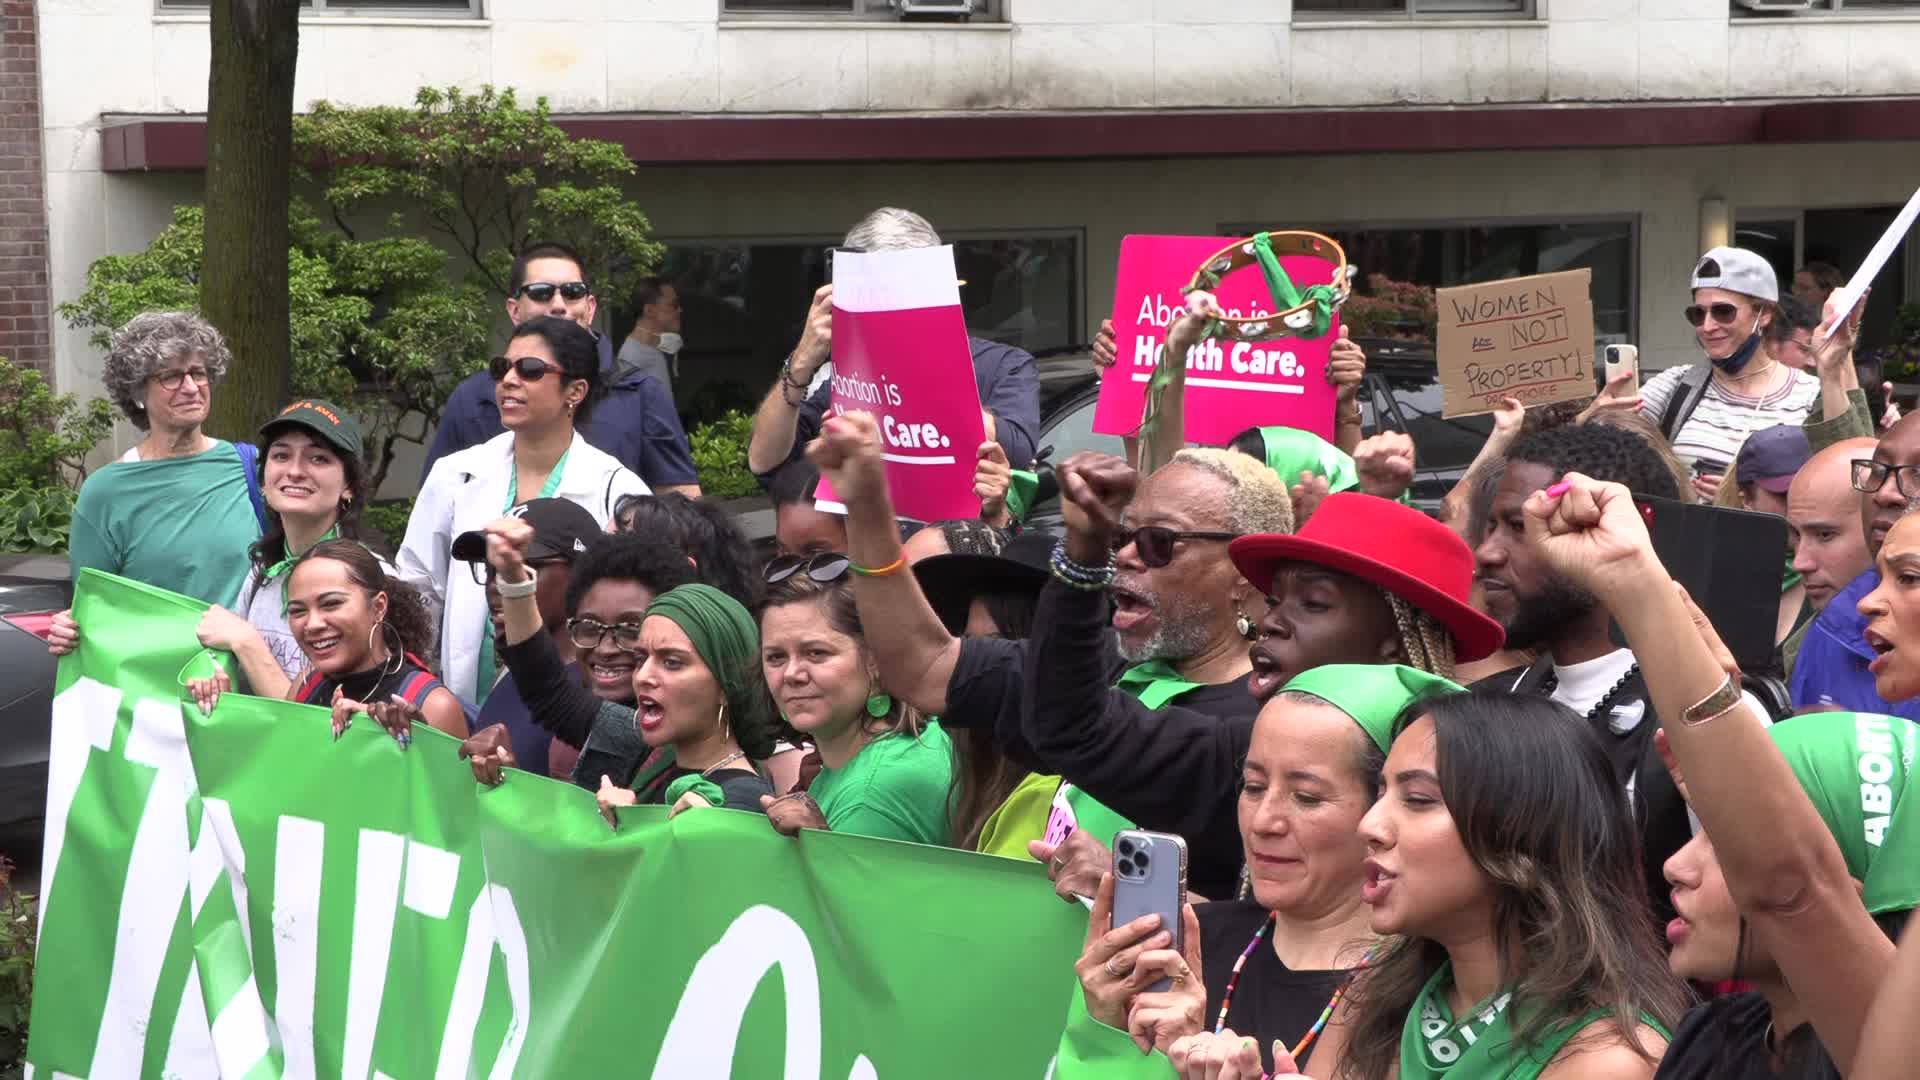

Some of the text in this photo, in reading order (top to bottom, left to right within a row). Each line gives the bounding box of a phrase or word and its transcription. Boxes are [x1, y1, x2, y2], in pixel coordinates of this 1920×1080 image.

[1452, 285, 1556, 323] WOMEN
[1512, 313, 1563, 345] NOT
[1230, 341, 1305, 378] Care.
[1464, 348, 1585, 396] PROPERTY!
[881, 374, 902, 406] is
[883, 414, 950, 448] Care.
